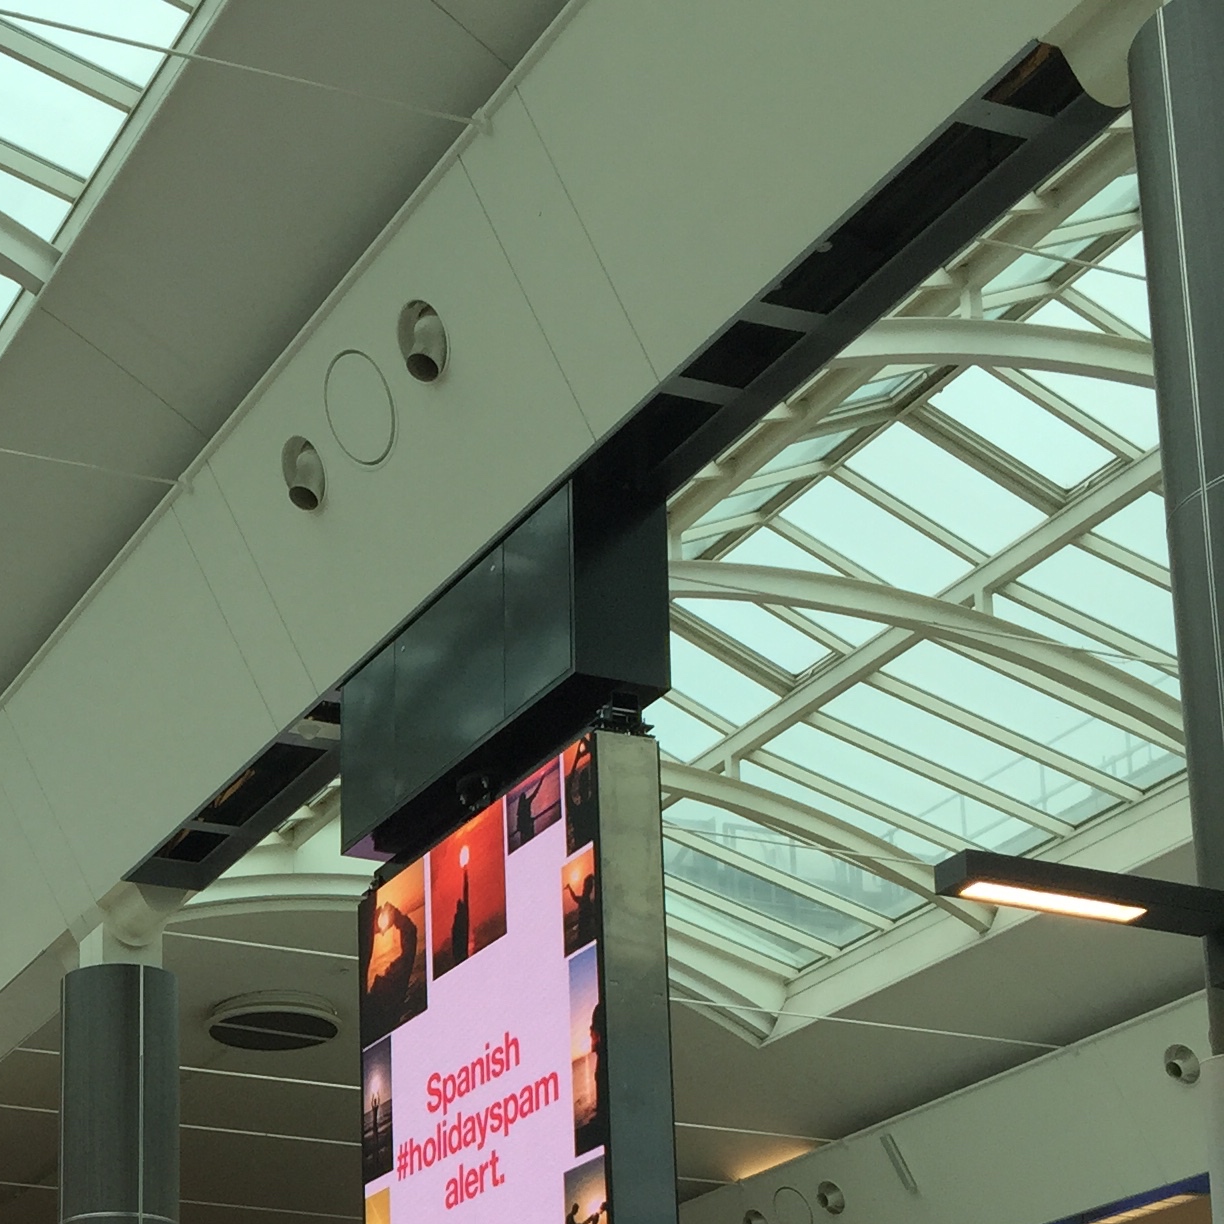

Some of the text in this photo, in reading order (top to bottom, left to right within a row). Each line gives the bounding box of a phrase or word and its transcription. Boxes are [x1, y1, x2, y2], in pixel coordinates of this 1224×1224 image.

[426, 1031, 520, 1115] Spanish
[396, 1071, 559, 1181] #holidayspam
[444, 1150, 505, 1210] alert.
